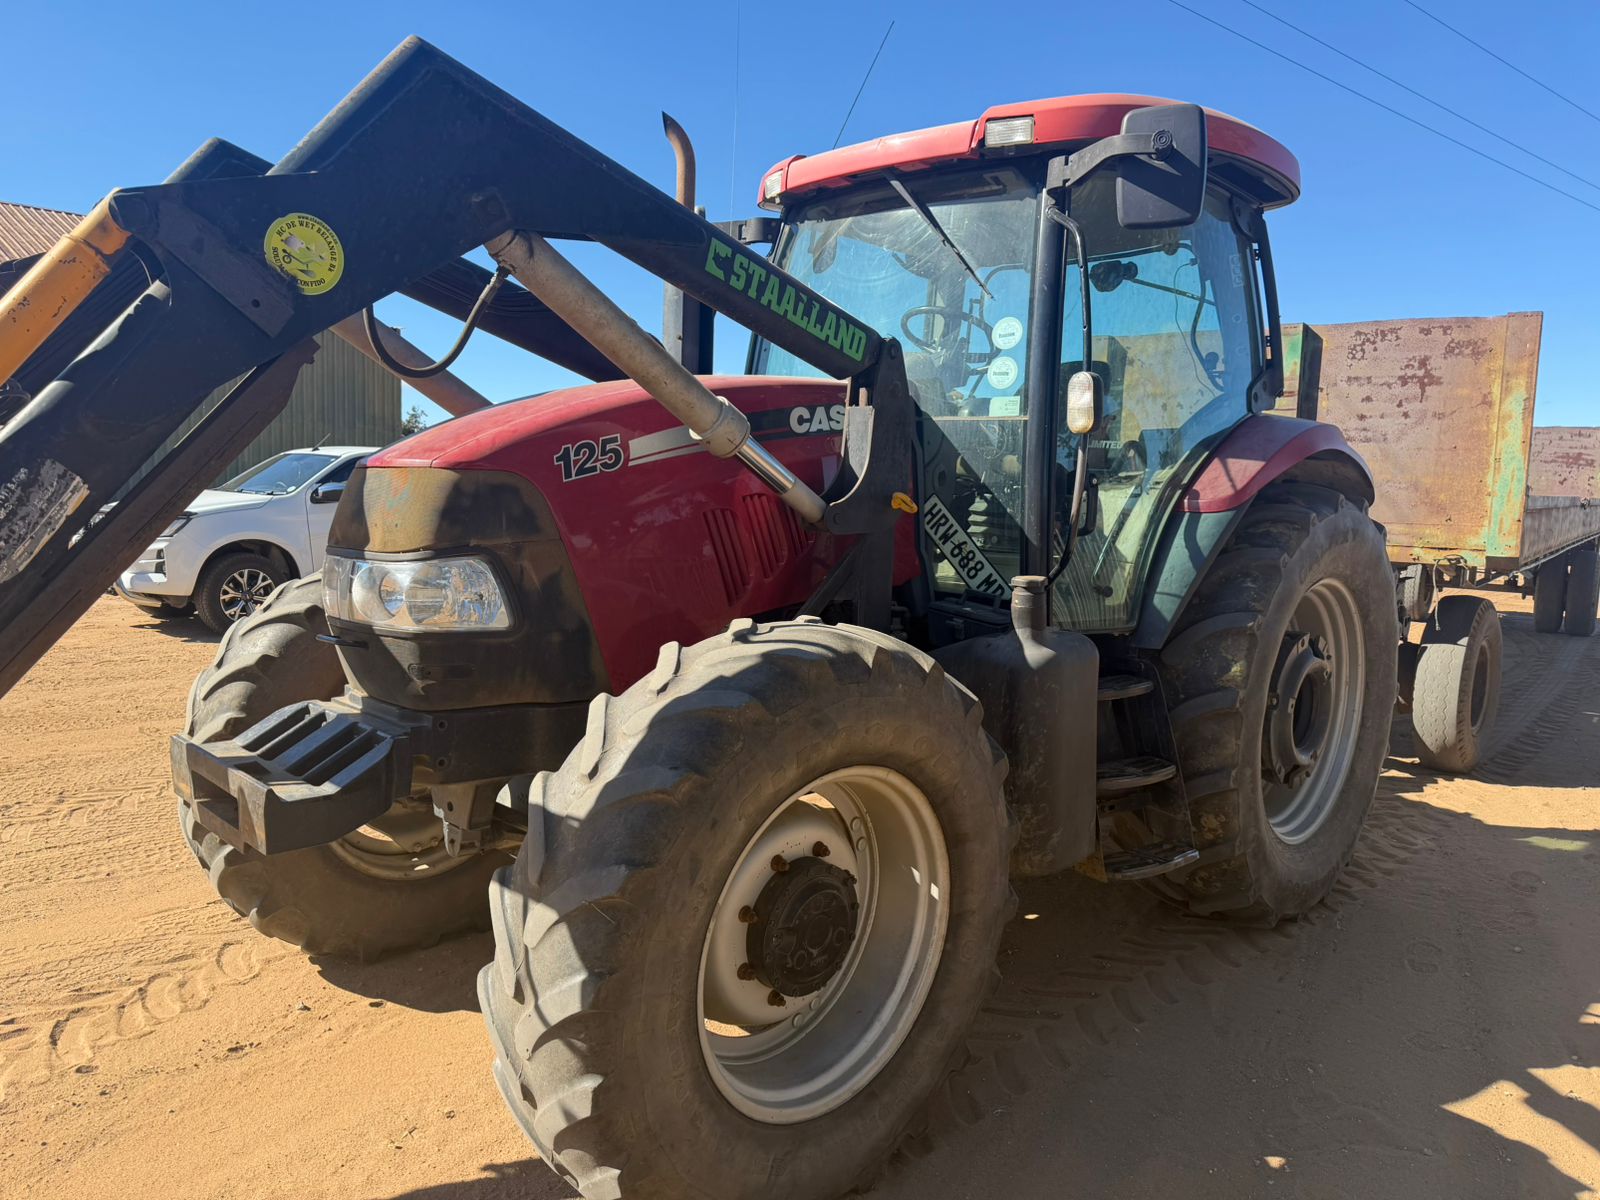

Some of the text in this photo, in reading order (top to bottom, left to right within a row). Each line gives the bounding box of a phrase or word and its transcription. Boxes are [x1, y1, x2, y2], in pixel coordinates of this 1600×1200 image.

[275, 225, 287, 238] HC
[285, 220, 297, 230] DE
[298, 219, 316, 230] WET
[316, 227, 337, 262] BELANGE
[789, 404, 845, 434] CAS
[553, 433, 624, 483] 125
